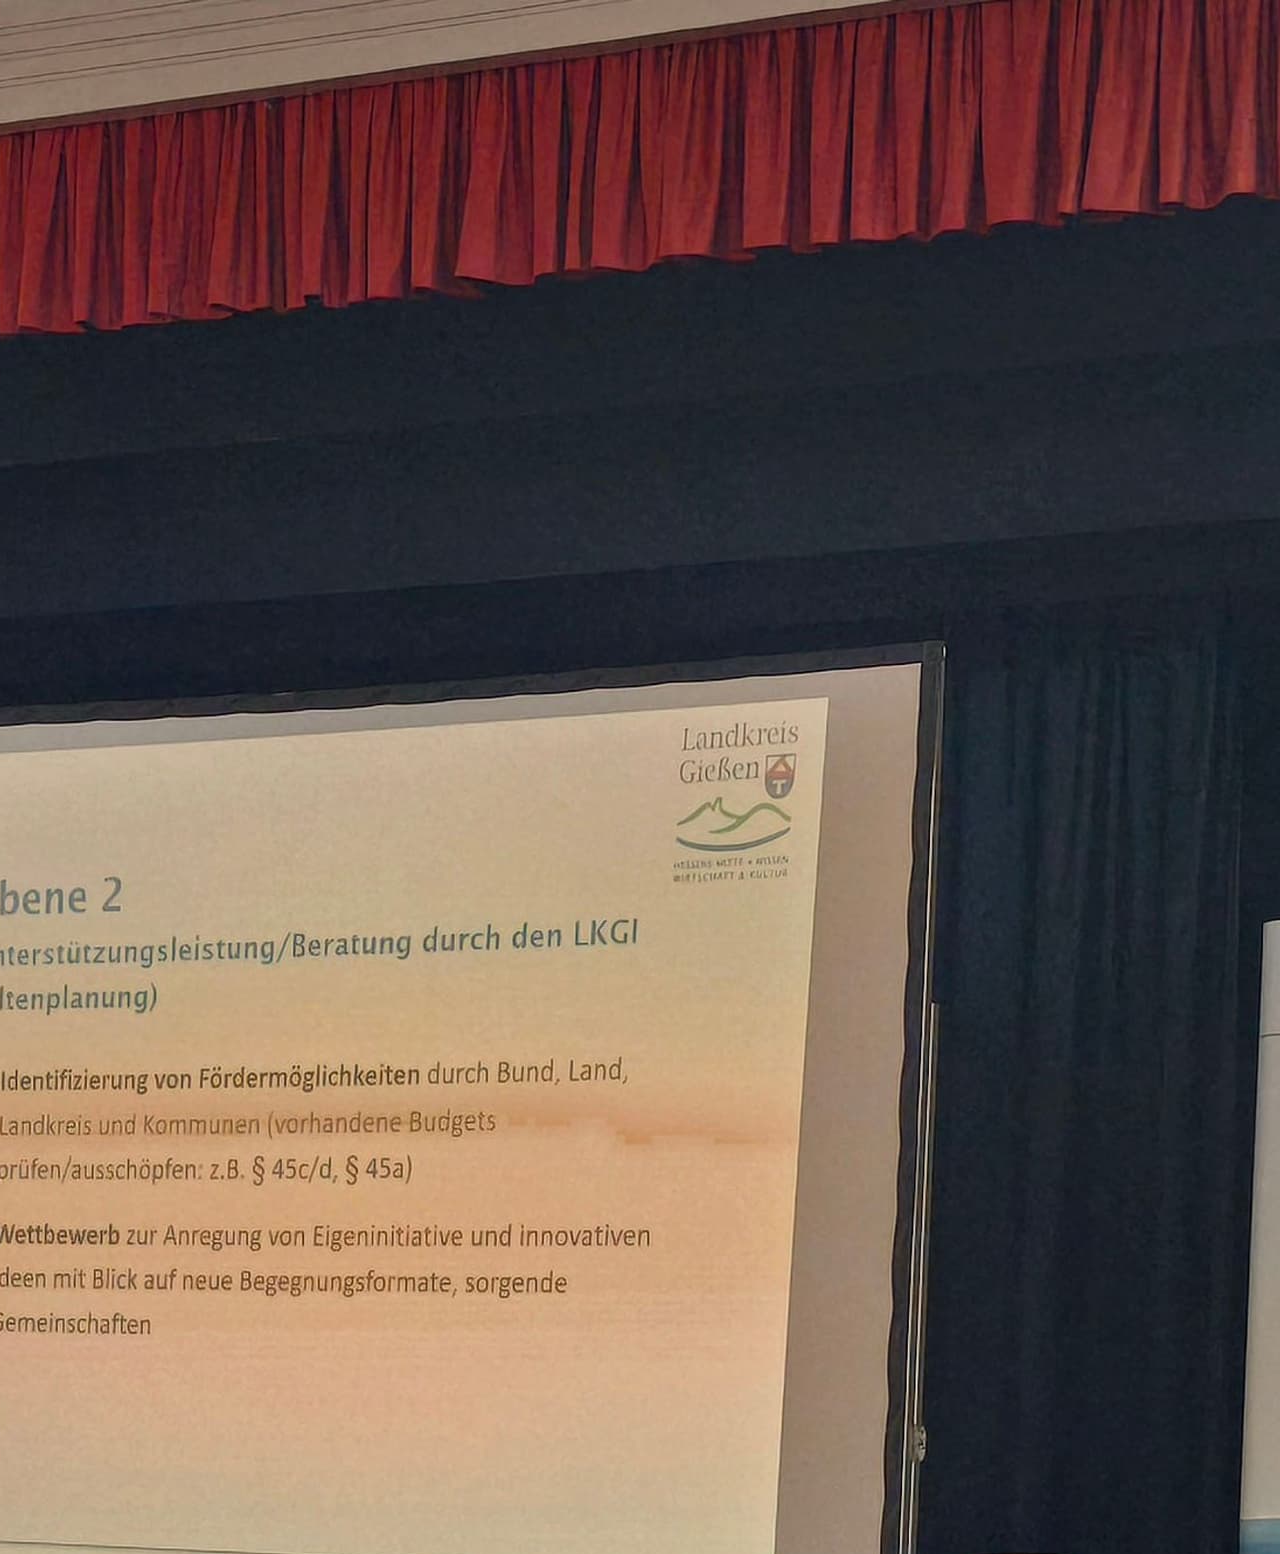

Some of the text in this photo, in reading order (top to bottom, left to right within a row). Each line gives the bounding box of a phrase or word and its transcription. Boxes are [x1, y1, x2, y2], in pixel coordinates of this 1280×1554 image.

[682, 721, 799, 751] Landkreis
[680, 757, 759, 784] Gießen
[101, 876, 122, 913] 2
[422, 920, 501, 952] durch
[511, 922, 562, 949] den
[574, 918, 639, 947] LKGI
[0, 1056, 629, 1095] Identifizierung von Fördermöglichkeiten durch Bund, Land,
[98, 1113, 137, 1136] und
[143, 1113, 260, 1136] Kommunen
[267, 1111, 401, 1139] (vorhandene
[409, 1111, 497, 1138] Budgets
[209, 1157, 245, 1181] z.B.
[252, 1154, 266, 1187] §
[271, 1155, 339, 1184] 45c/d,
[344, 1154, 359, 1186] §
[365, 1154, 413, 1185] 45a)
[126, 1229, 158, 1247] zur
[162, 1224, 262, 1252] Anregung
[267, 1228, 306, 1248] von
[312, 1222, 463, 1253] Eigeninitiative
[470, 1223, 512, 1248] und
[519, 1223, 652, 1248] innovativen
[53, 1268, 86, 1291] mit
[92, 1268, 138, 1291] Blick
[143, 1268, 177, 1292] auf
[182, 1273, 234, 1292] neue
[239, 1268, 458, 1299] Begegnungsformate,
[464, 1270, 568, 1300] sorgende
